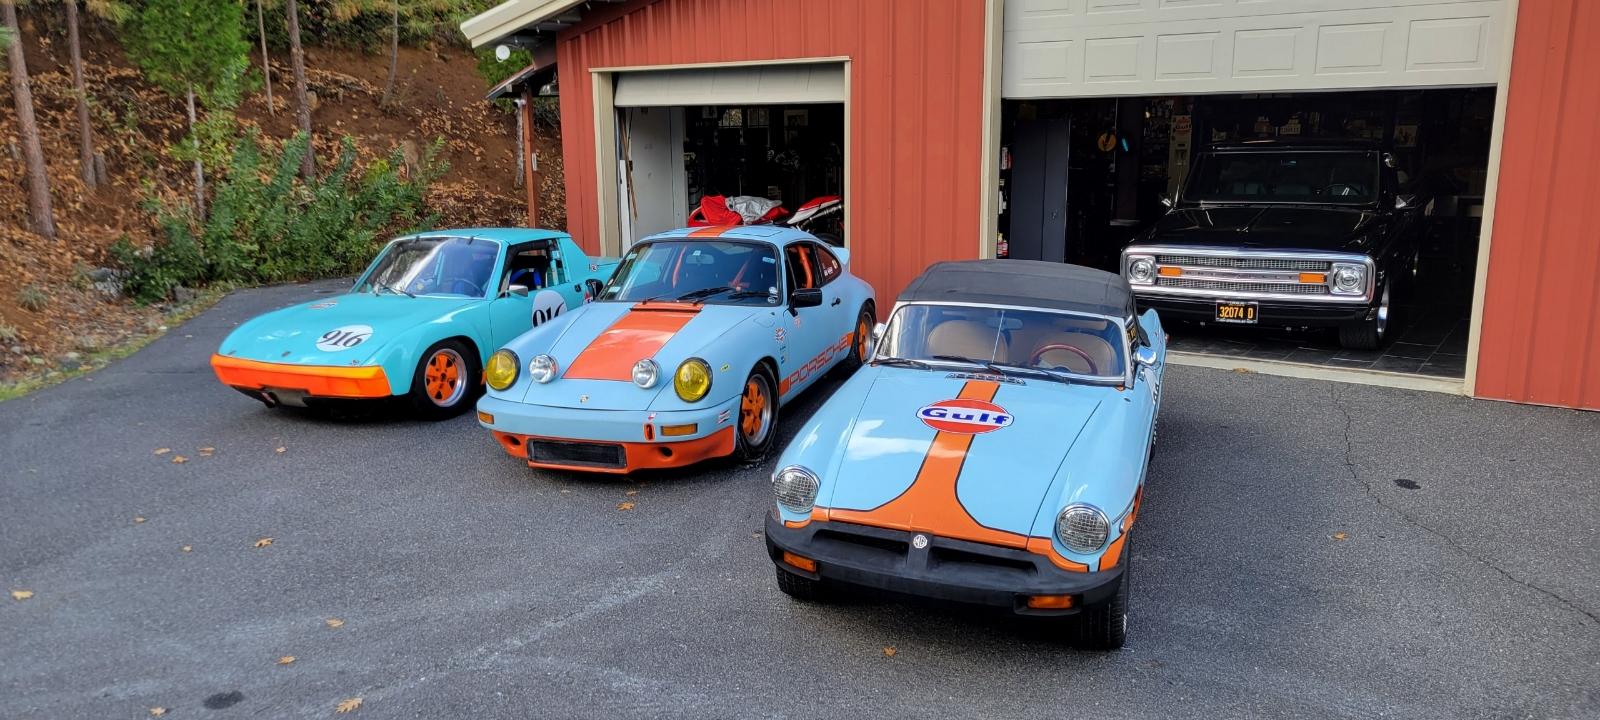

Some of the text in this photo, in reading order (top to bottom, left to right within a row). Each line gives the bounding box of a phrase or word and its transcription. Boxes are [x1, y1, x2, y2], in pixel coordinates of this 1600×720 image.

[1219, 306, 1244, 318] 32074
[316, 330, 373, 347] 916
[788, 336, 848, 388] PORSCHE
[921, 407, 1009, 425] Gulf
